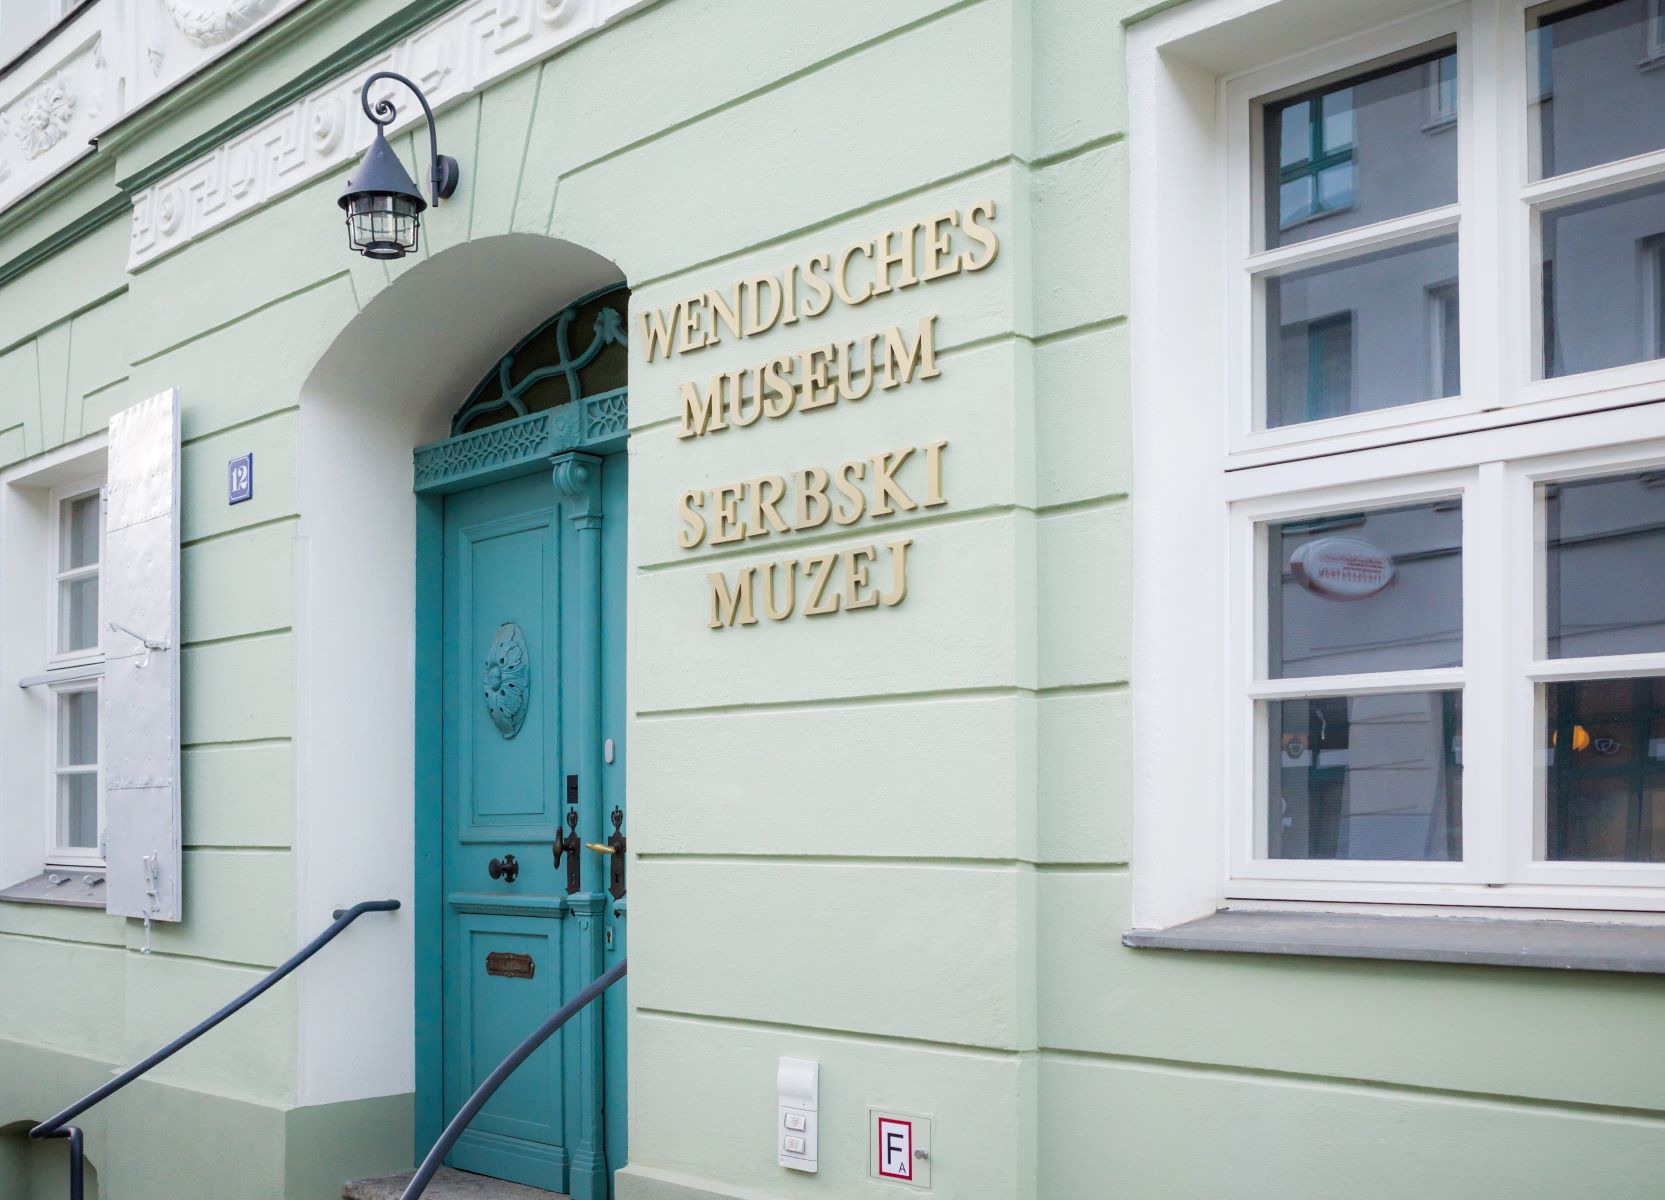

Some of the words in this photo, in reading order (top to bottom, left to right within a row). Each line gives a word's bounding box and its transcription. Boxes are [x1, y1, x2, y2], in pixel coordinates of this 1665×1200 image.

[636, 201, 999, 363] WENDISCHES
[676, 314, 942, 440] MUSEUM
[232, 464, 248, 492] 12
[677, 440, 948, 549] SERBSKI
[706, 539, 913, 629] MUZEJ
[887, 1132, 904, 1164] F
[898, 1162, 906, 1173] A
